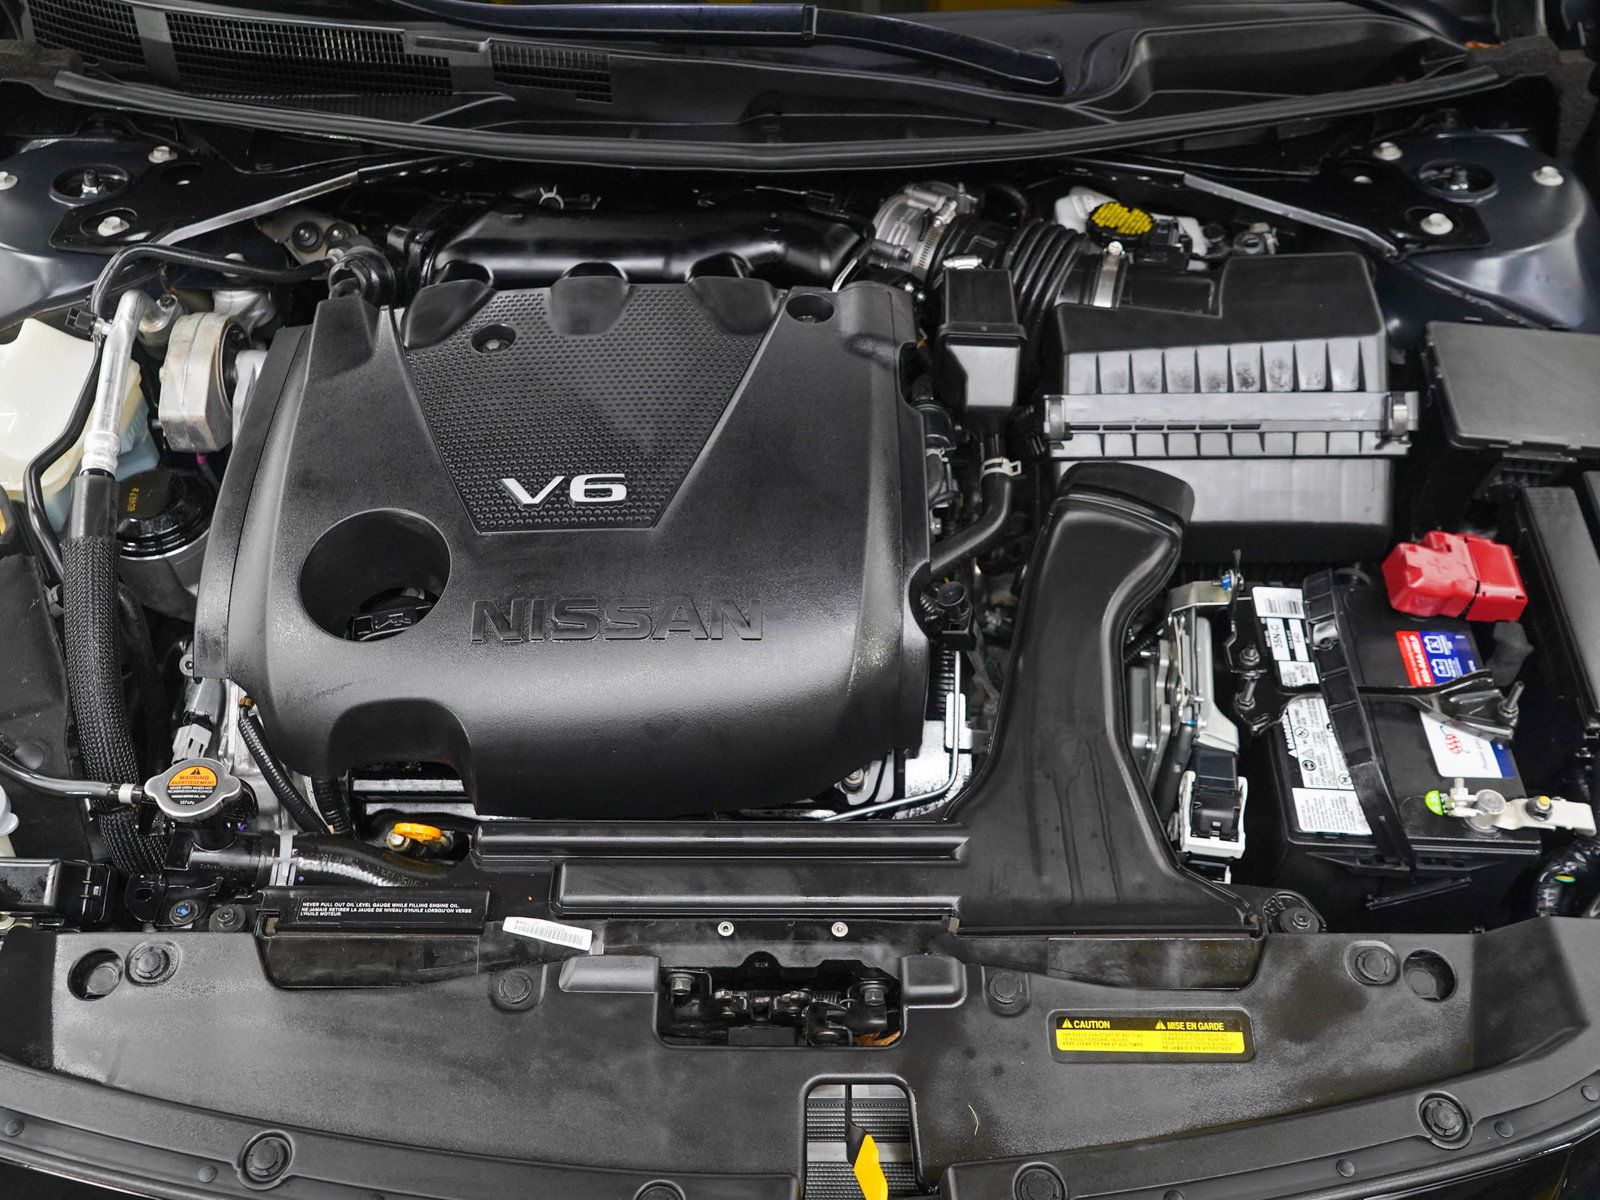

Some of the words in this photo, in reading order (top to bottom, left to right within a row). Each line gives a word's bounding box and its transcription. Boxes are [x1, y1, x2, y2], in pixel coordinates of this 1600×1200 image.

[501, 473, 628, 507] V6
[471, 599, 763, 642] NISSAN
[1073, 1020, 1110, 1028] CAUTION
[1166, 1022, 1185, 1030] MISE
[1186, 1022, 1197, 1030] EN
[1198, 1022, 1224, 1030] GARDE
